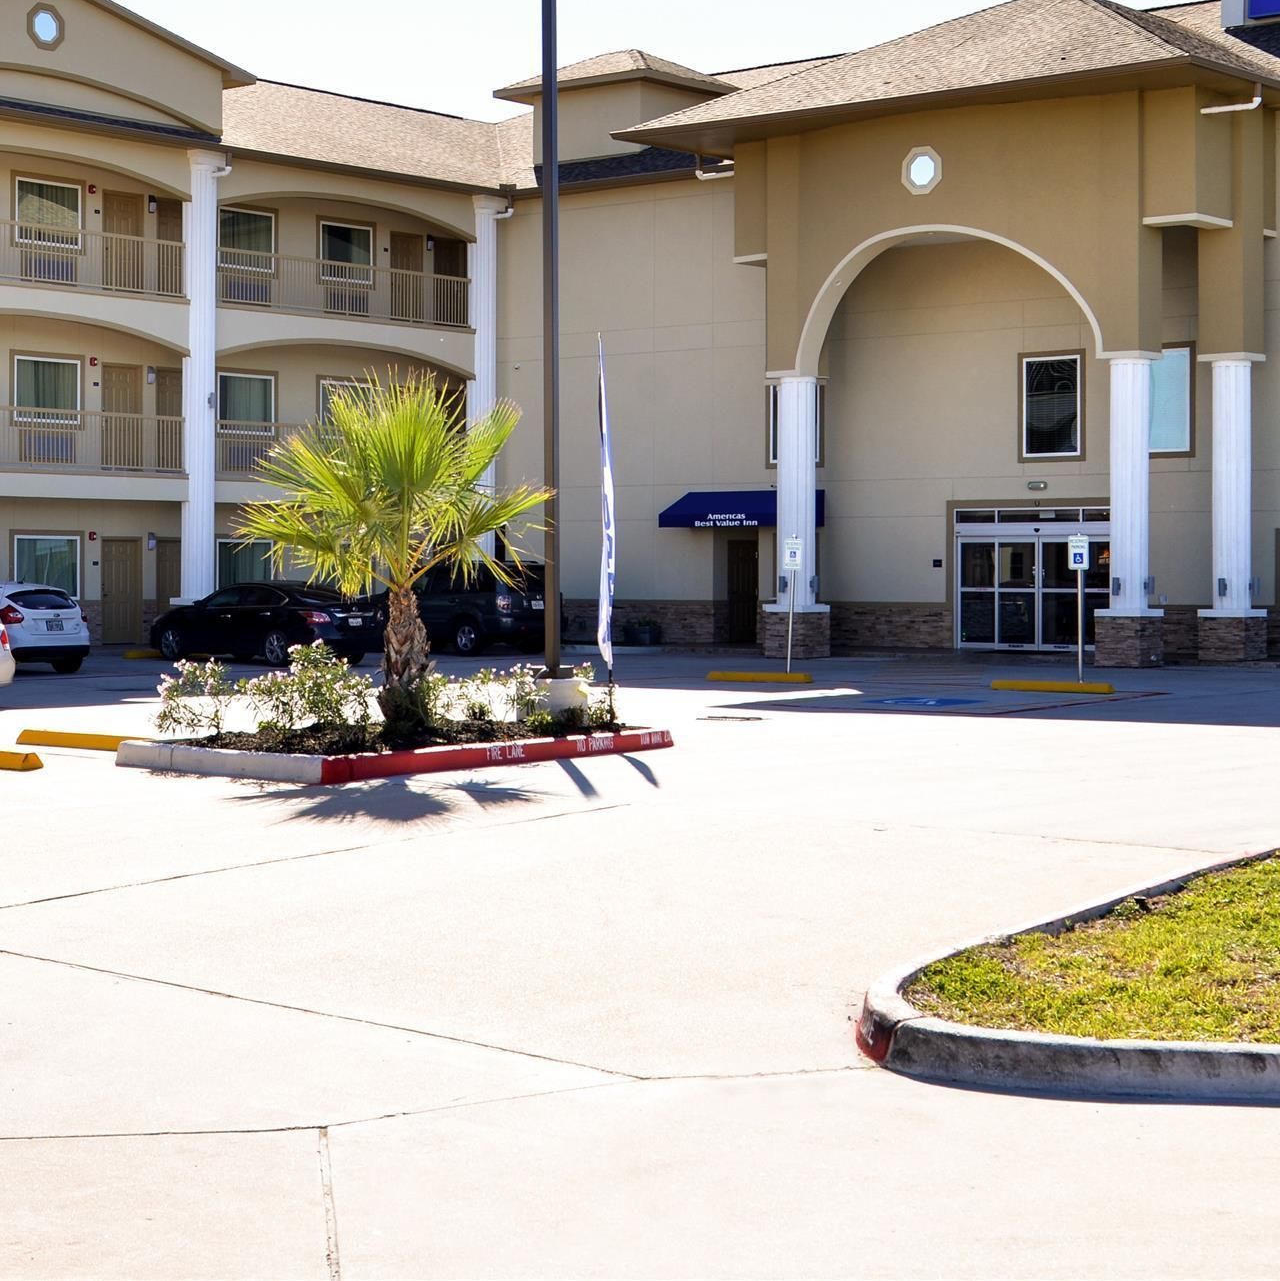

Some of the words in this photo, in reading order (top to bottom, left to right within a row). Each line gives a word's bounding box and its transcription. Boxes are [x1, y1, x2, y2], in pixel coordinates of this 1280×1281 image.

[486, 745, 503, 760] FIRE
[506, 743, 526, 759] LANE
[576, 738, 586, 752] NO
[588, 737, 614, 751] PARKING
